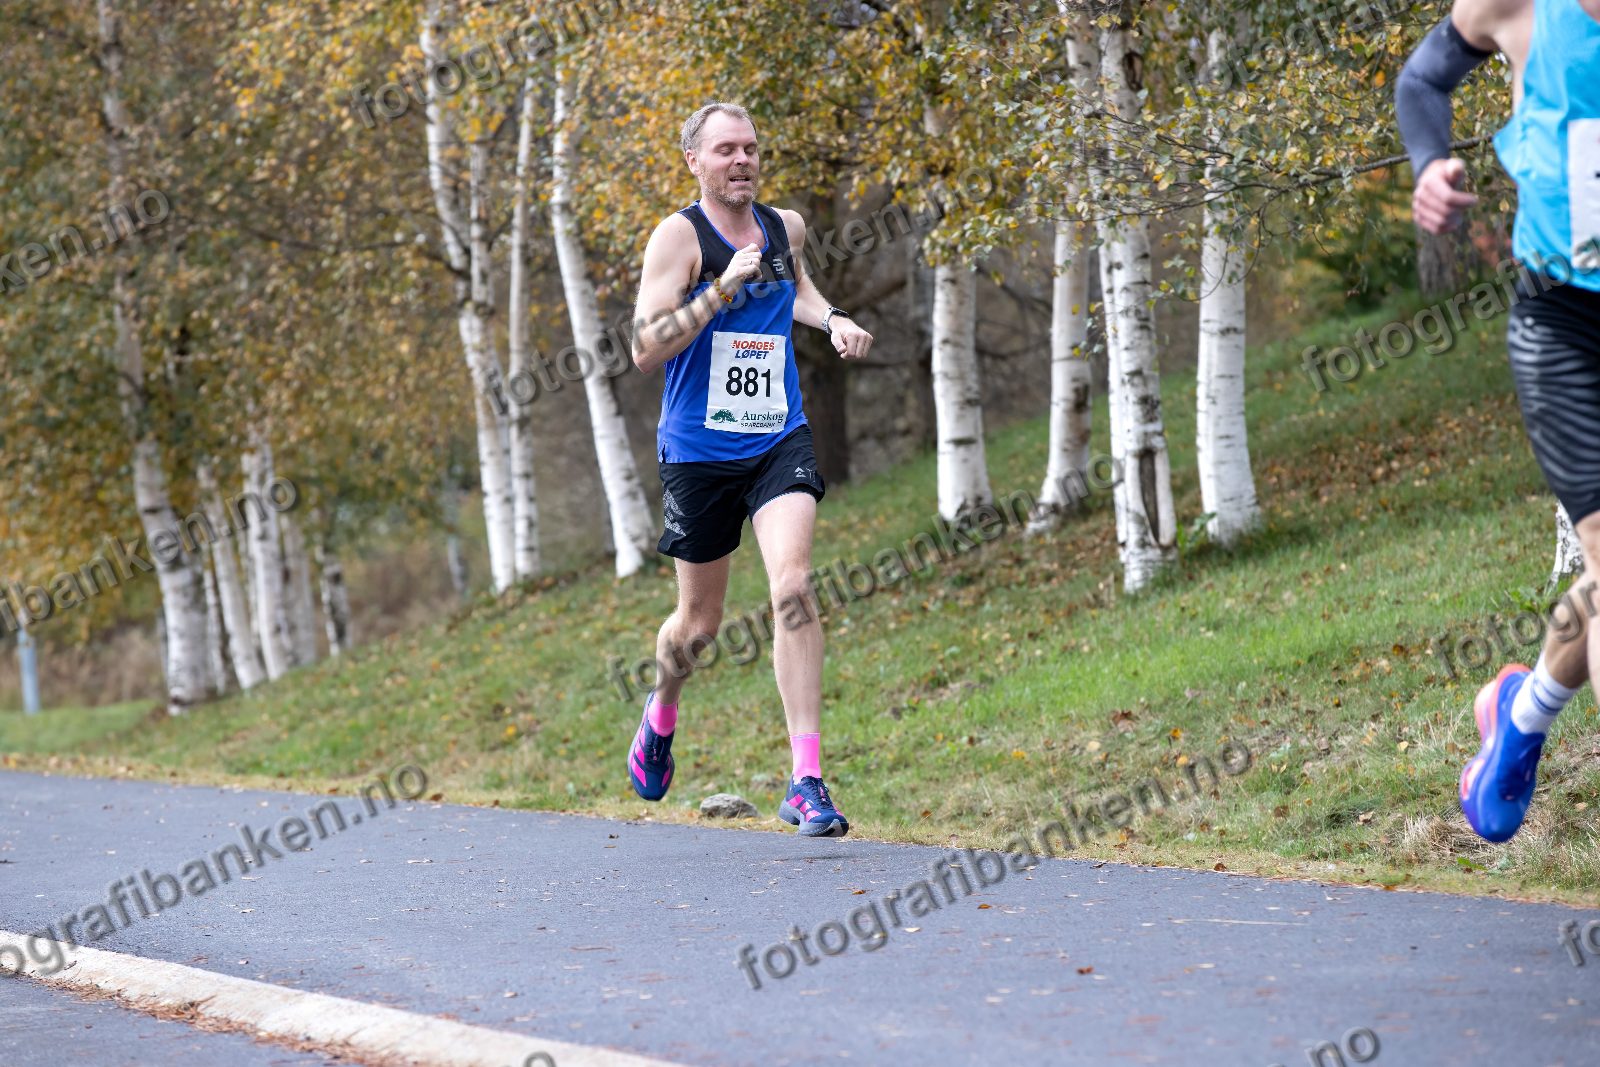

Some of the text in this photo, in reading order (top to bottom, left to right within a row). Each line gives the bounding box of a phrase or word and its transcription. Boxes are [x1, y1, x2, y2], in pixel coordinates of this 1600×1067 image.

[732, 340, 775, 350] NORGES
[735, 350, 769, 360] LØPET
[726, 366, 771, 397] 881
[741, 411, 784, 424] Aurskog
